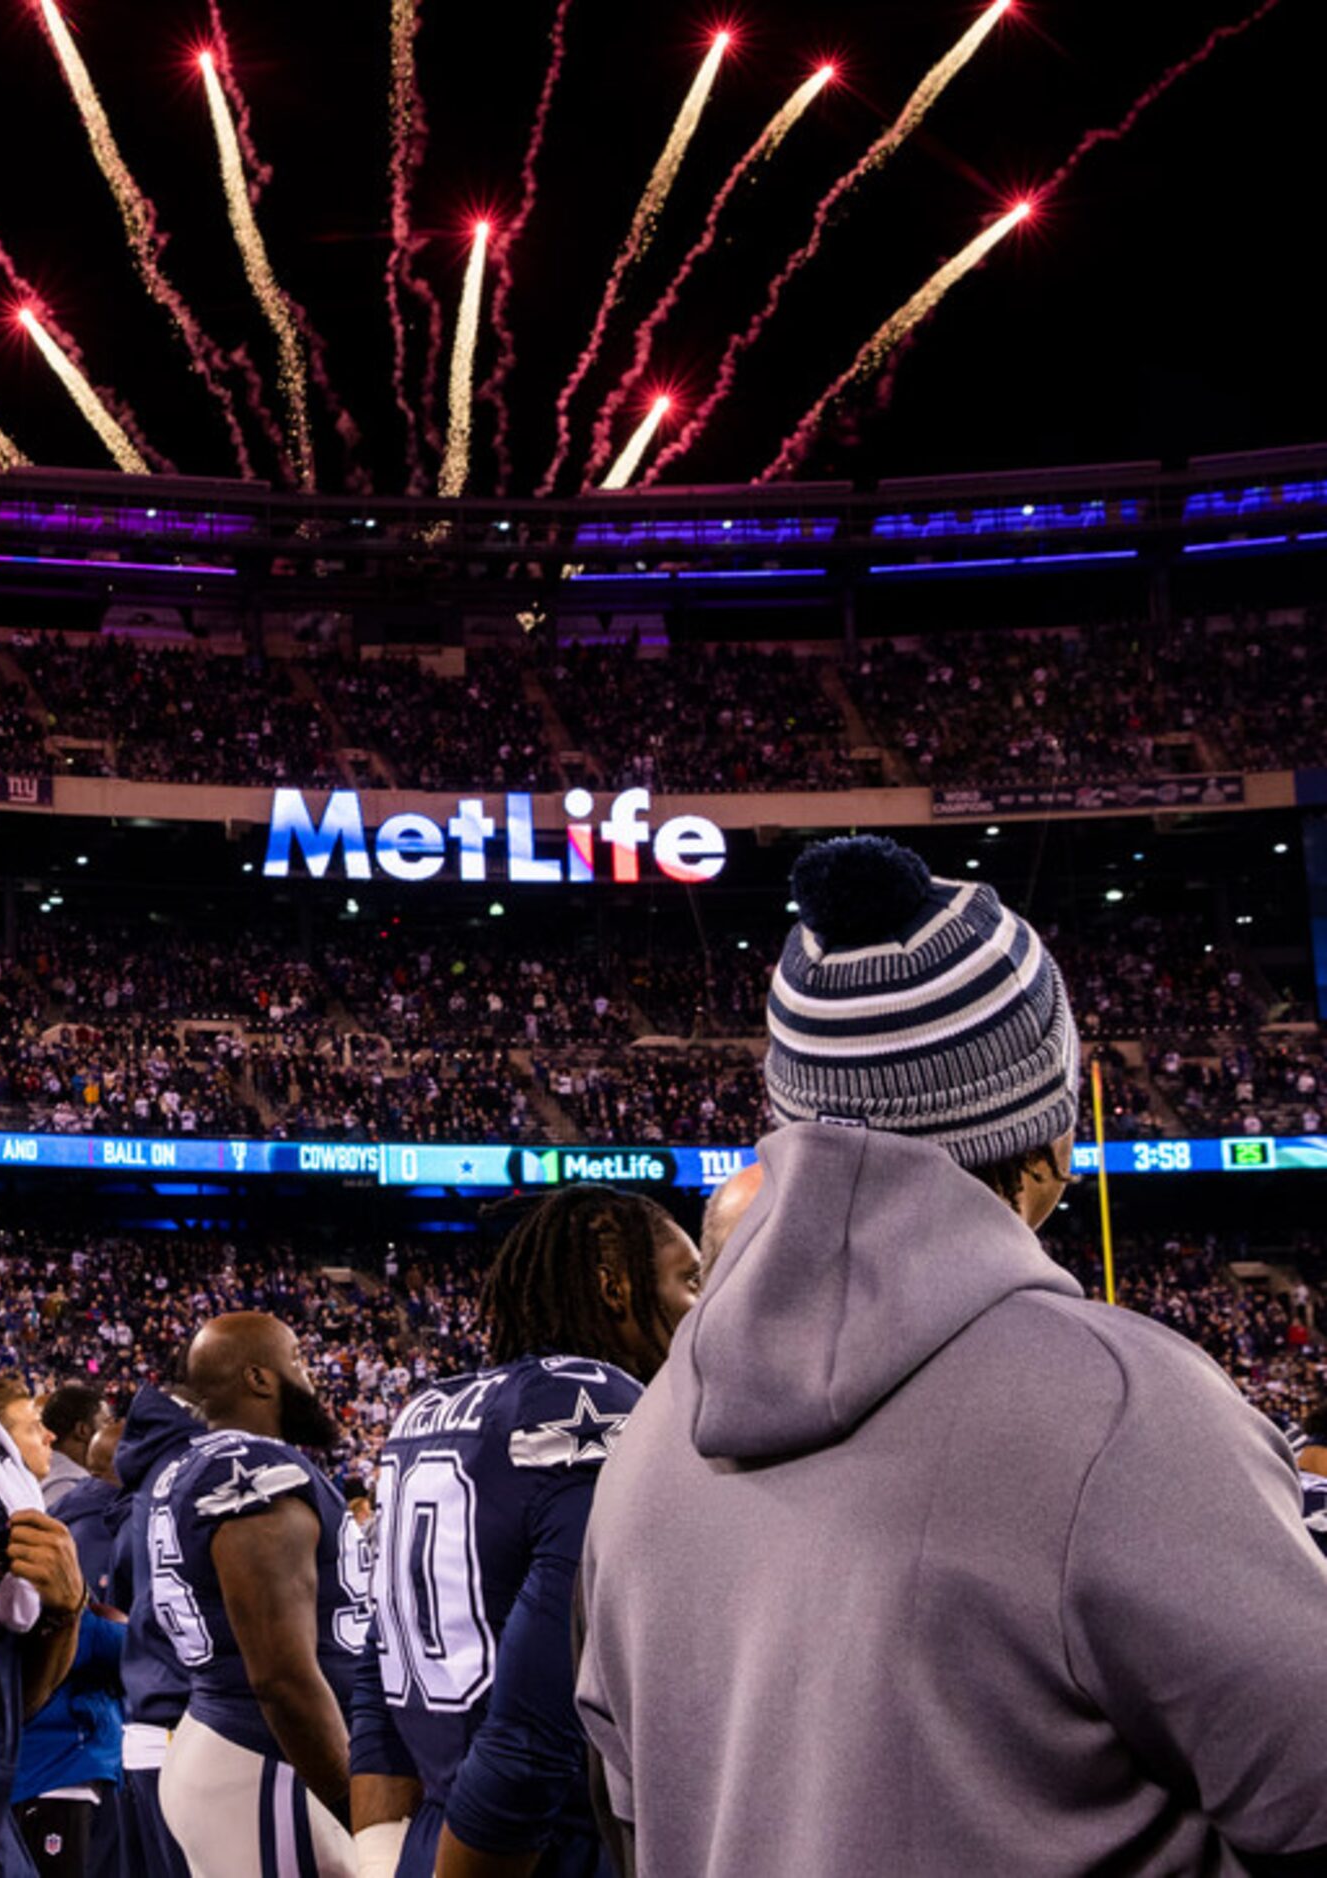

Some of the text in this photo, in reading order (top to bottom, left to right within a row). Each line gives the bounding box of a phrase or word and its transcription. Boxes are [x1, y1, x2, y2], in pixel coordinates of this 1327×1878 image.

[263, 787, 727, 882] MetLife
[103, 1142, 147, 1165] BALL
[151, 1143, 177, 1167] ON
[299, 1145, 378, 1171] COWBOYS
[564, 1154, 666, 1180] MetLife
[1132, 1141, 1191, 1172] 3:58
